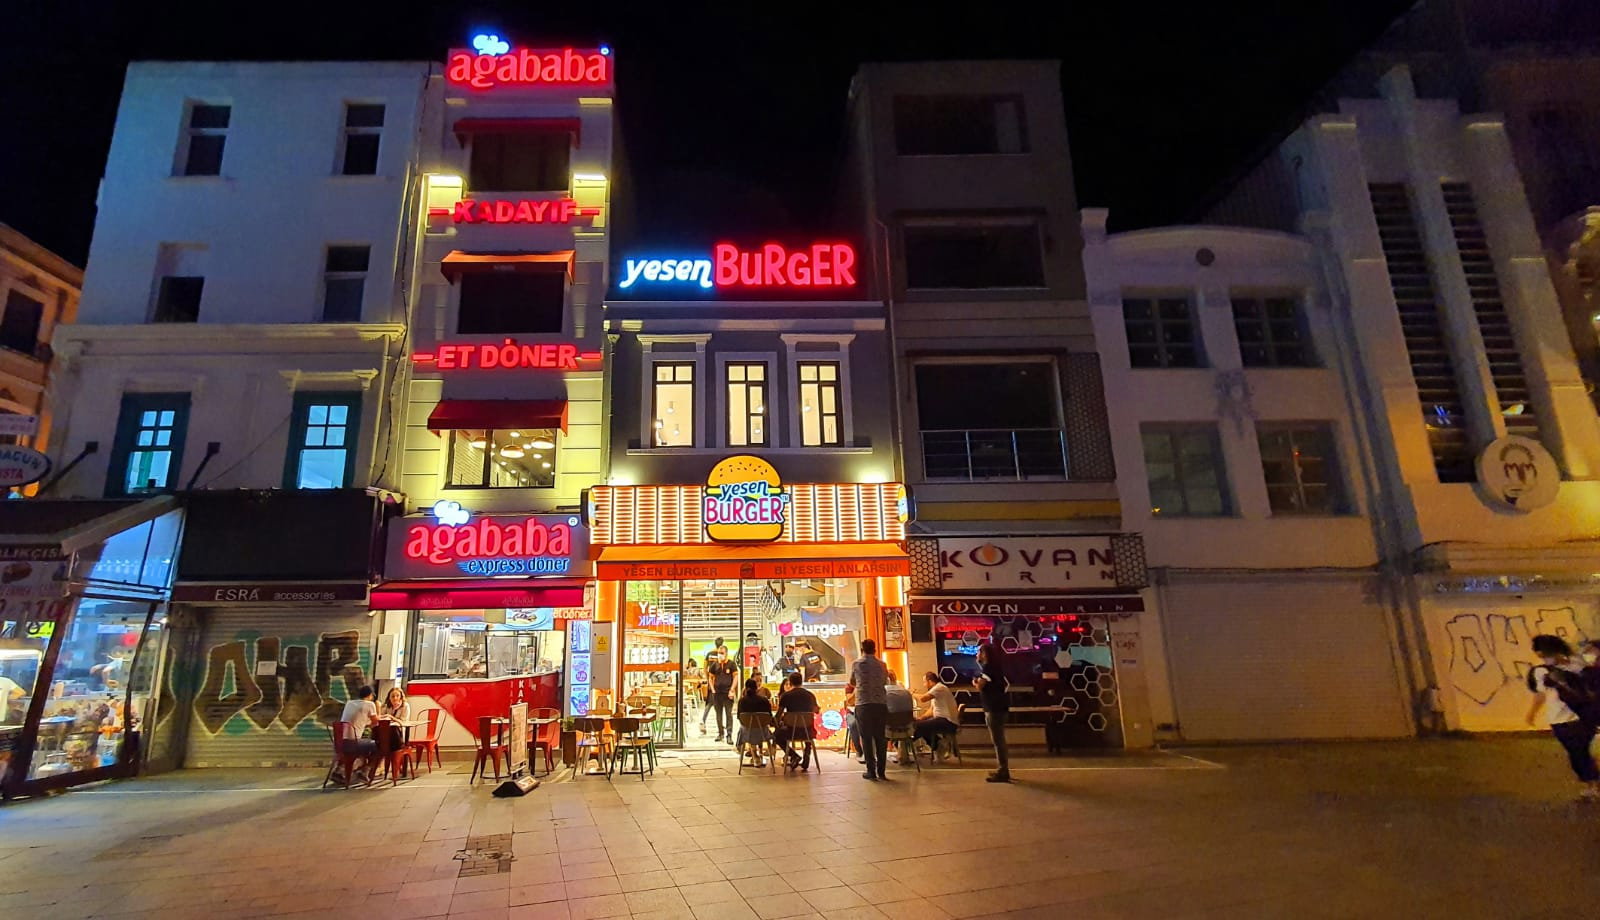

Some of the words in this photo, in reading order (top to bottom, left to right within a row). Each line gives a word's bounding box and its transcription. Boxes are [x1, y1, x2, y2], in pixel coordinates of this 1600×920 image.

[450, 49, 606, 87] agababa
[454, 201, 576, 223] KADAYIF
[619, 259, 713, 289] yesen
[438, 345, 475, 369] ET
[720, 480, 768, 501] yesen
[407, 518, 570, 564] agababa
[941, 542, 1115, 568] KOVAN
[468, 559, 523, 575] express
[528, 557, 570, 572] döner
[622, 567, 663, 577] YESEN
[666, 567, 718, 577] BURGER
[790, 564, 831, 575] YESEN
[273, 591, 336, 600] accessories
[931, 600, 1018, 614] KOVAN
[792, 622, 847, 639] Burger
